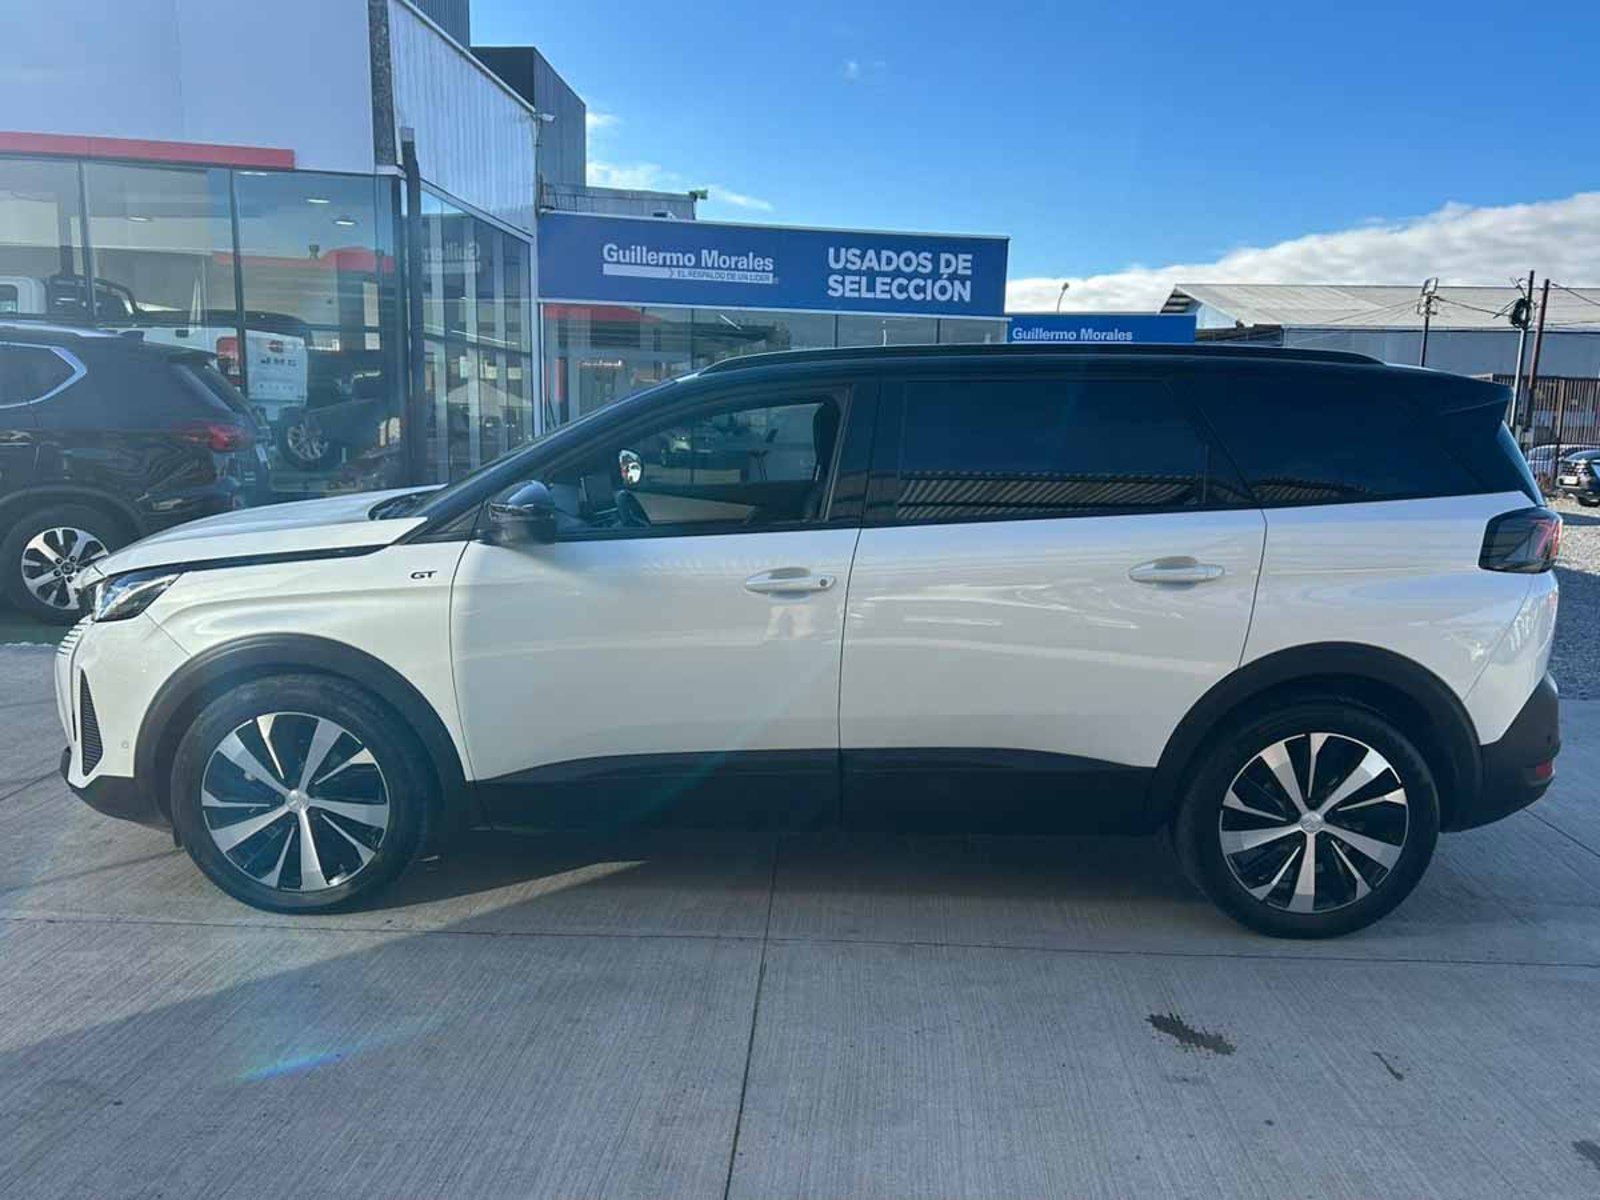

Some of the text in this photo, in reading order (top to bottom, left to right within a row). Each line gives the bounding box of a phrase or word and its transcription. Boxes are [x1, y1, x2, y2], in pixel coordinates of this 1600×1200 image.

[603, 243, 774, 271] Guillermo Morales
[828, 247, 973, 275] USADOS DE
[827, 274, 972, 302] SELECCIÓN
[1012, 327, 1133, 341] Guillermo Morales
[410, 570, 438, 579] GT
